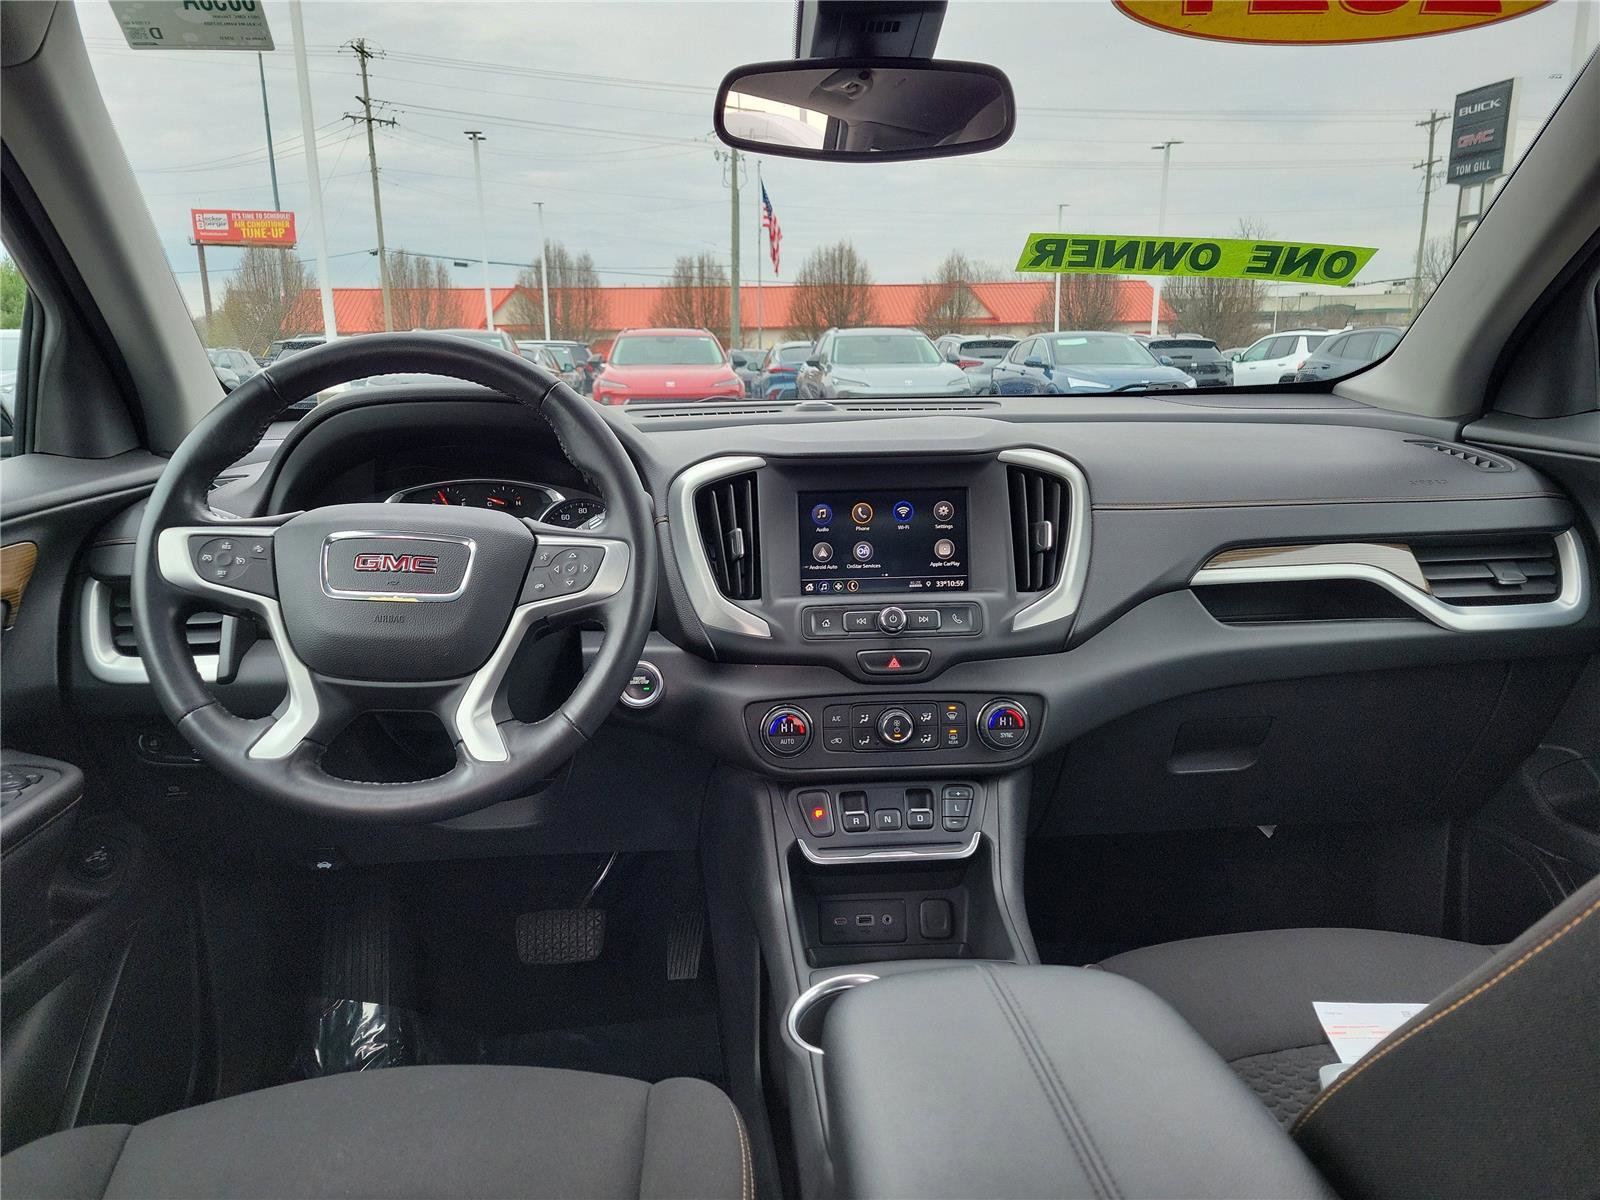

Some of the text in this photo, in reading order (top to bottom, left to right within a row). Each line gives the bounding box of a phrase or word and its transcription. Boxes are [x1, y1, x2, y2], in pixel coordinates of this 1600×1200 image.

[1459, 97, 1503, 116] BUICK
[1456, 128, 1495, 148] GMC
[1456, 159, 1491, 176] TOM GILL
[234, 220, 290, 228] AIR CONDITIONER
[240, 228, 285, 238] TUNE-UP
[561, 513, 570, 521] 60
[354, 553, 438, 575] GMC
[374, 614, 405, 624] AIRBAG
[832, 714, 841, 722] A/C
[954, 804, 960, 812] L
[853, 817, 860, 825] R
[917, 814, 924, 822] D
